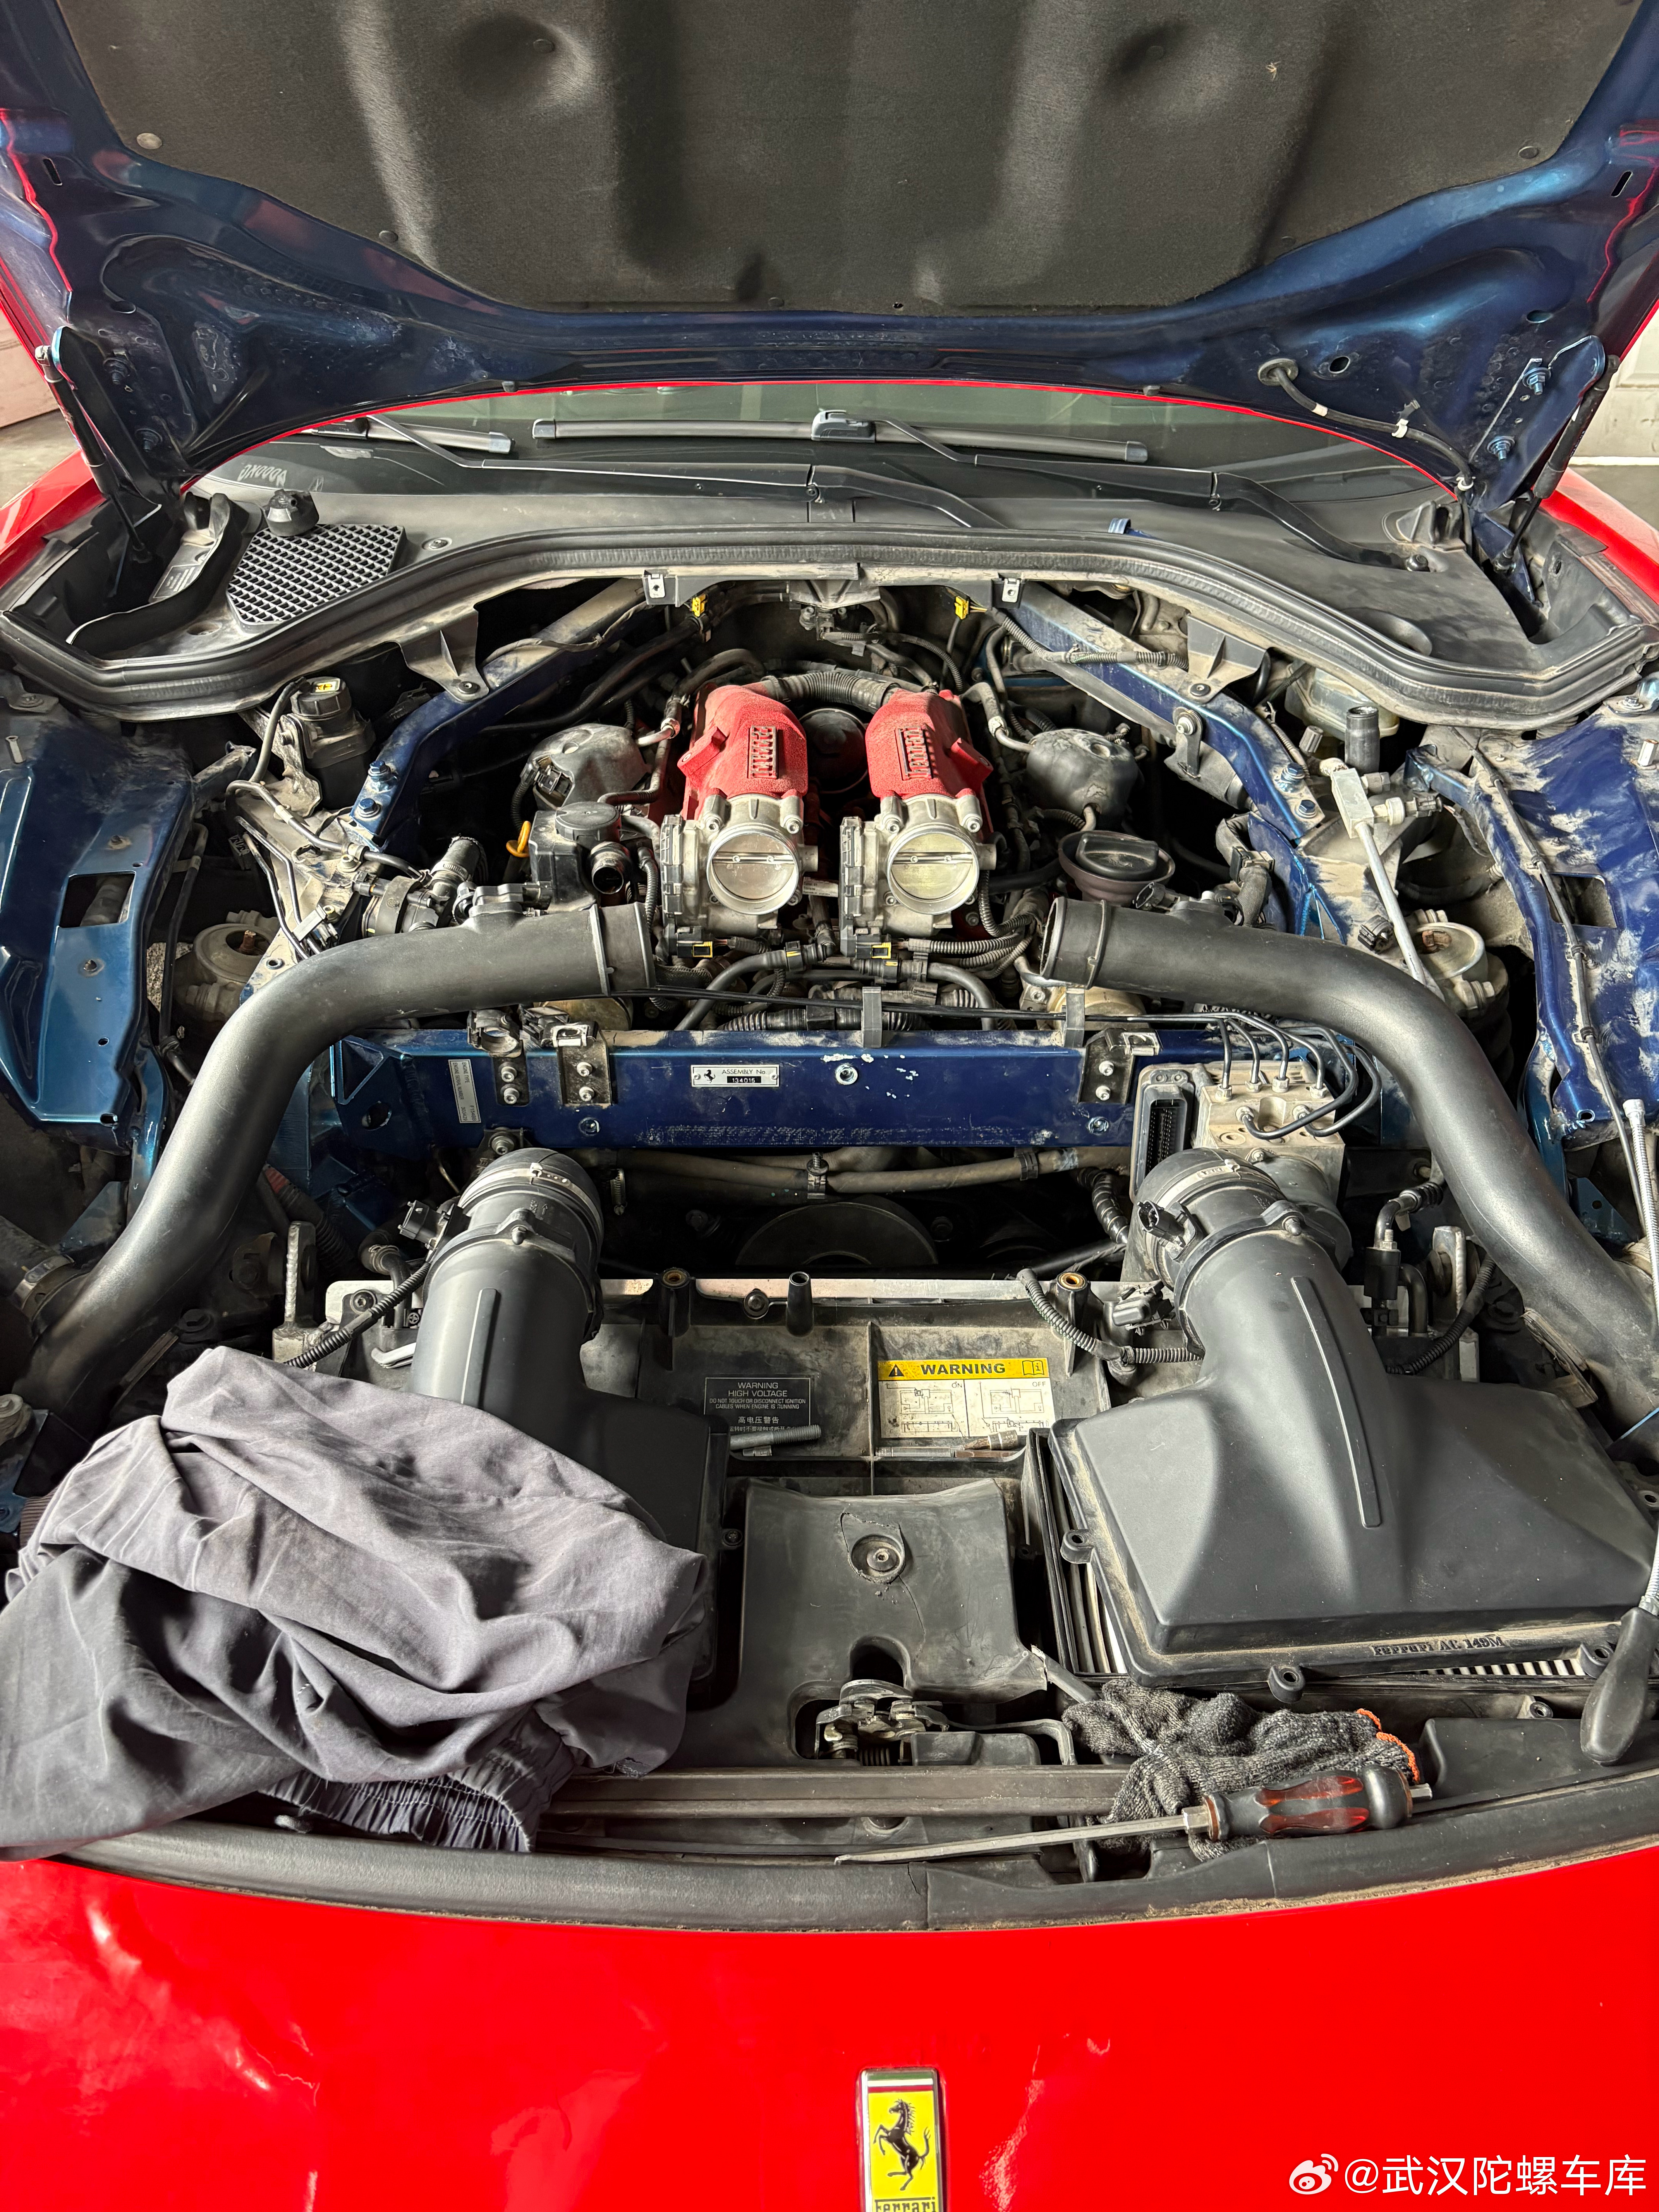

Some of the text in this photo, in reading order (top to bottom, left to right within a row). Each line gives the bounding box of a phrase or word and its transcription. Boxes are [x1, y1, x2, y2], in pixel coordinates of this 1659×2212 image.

[750, 726, 776, 778] Ferrari
[900, 726, 931, 778] Ferrari
[920, 1363, 1006, 1375] WARNING
[1463, 1636, 1505, 1649] 149M
[874, 2197, 936, 2212] Ferrari
